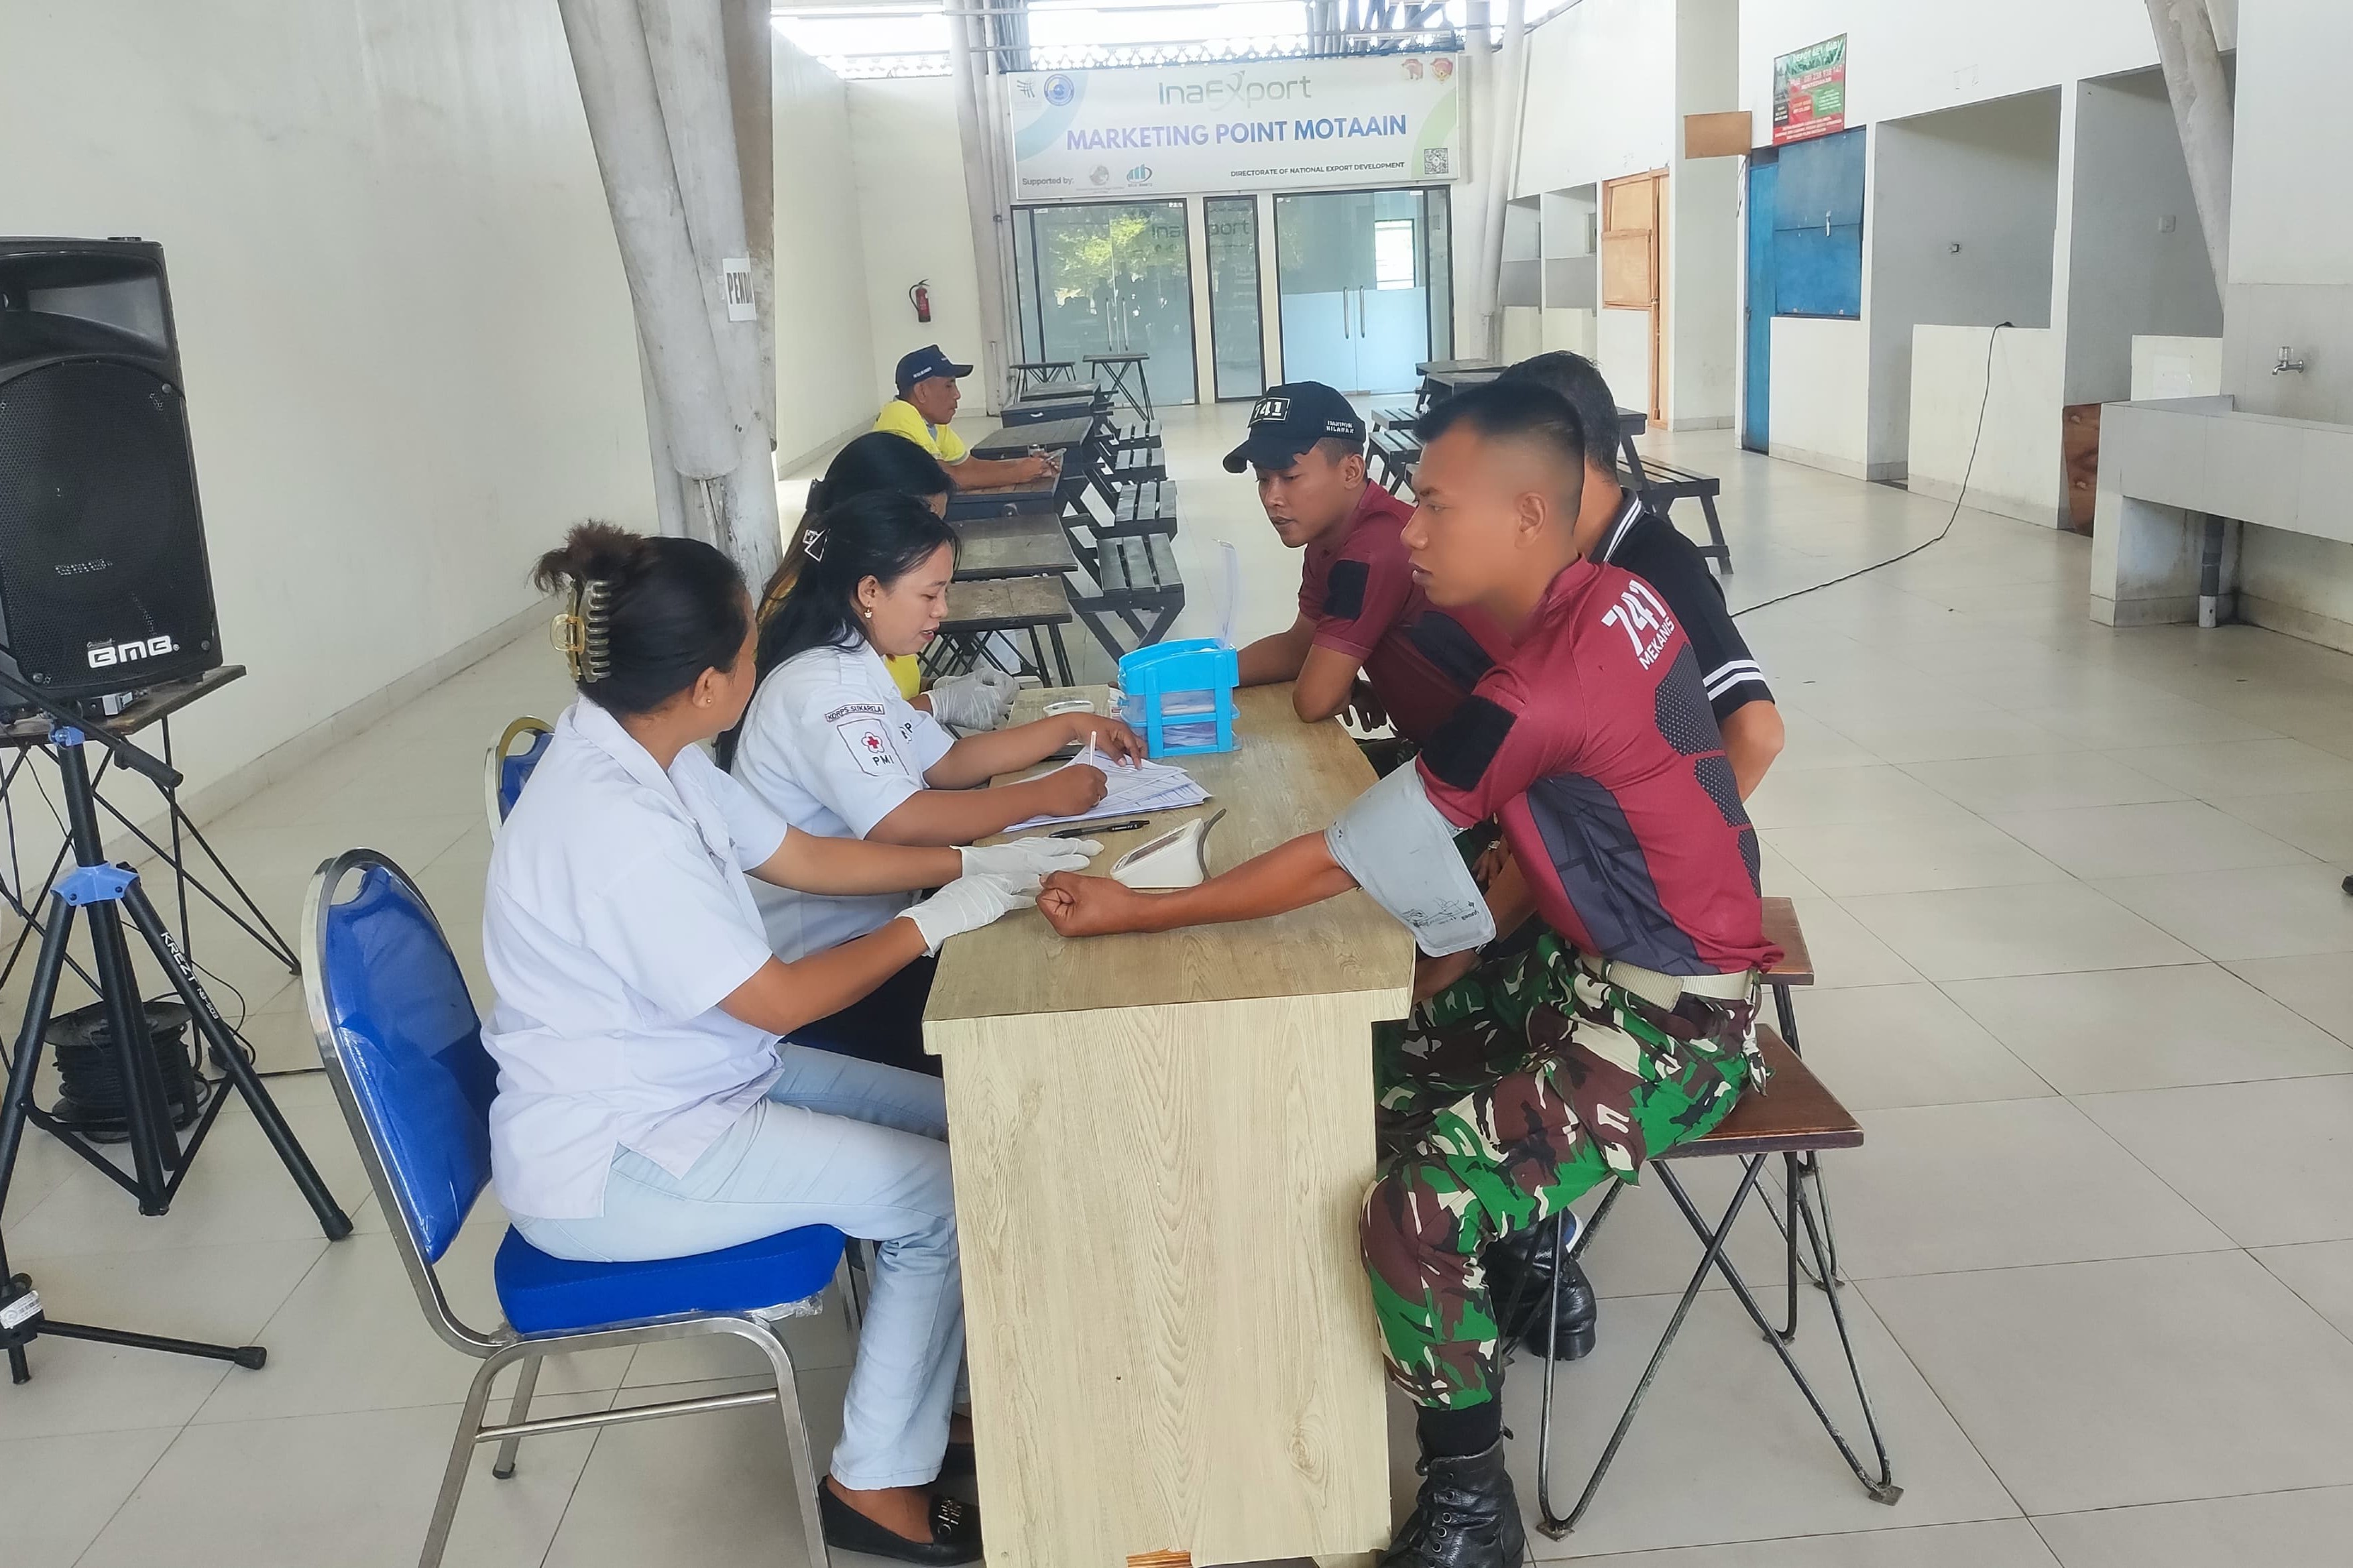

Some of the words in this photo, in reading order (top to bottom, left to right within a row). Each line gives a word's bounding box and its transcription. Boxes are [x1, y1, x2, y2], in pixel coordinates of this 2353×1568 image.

[1158, 70, 1312, 109] InaExport
[1067, 124, 1209, 150] MARKETING
[1216, 121, 1287, 144] POINT
[1294, 115, 1406, 140] MOTAAIN
[1022, 176, 1061, 186] Supported
[1230, 168, 1278, 177] DIRECTORATE
[1289, 166, 1325, 174] NATIONAL
[1326, 164, 1353, 172] EXPORT
[1354, 162, 1405, 171] DEVELOPMENT
[1253, 400, 1283, 419] 741
[1601, 579, 1667, 657] 741
[1638, 616, 1676, 670] MEKANIS
[827, 707, 850, 719] KORPS
[872, 754, 895, 766] PMI
[161, 932, 198, 982] KREZT
